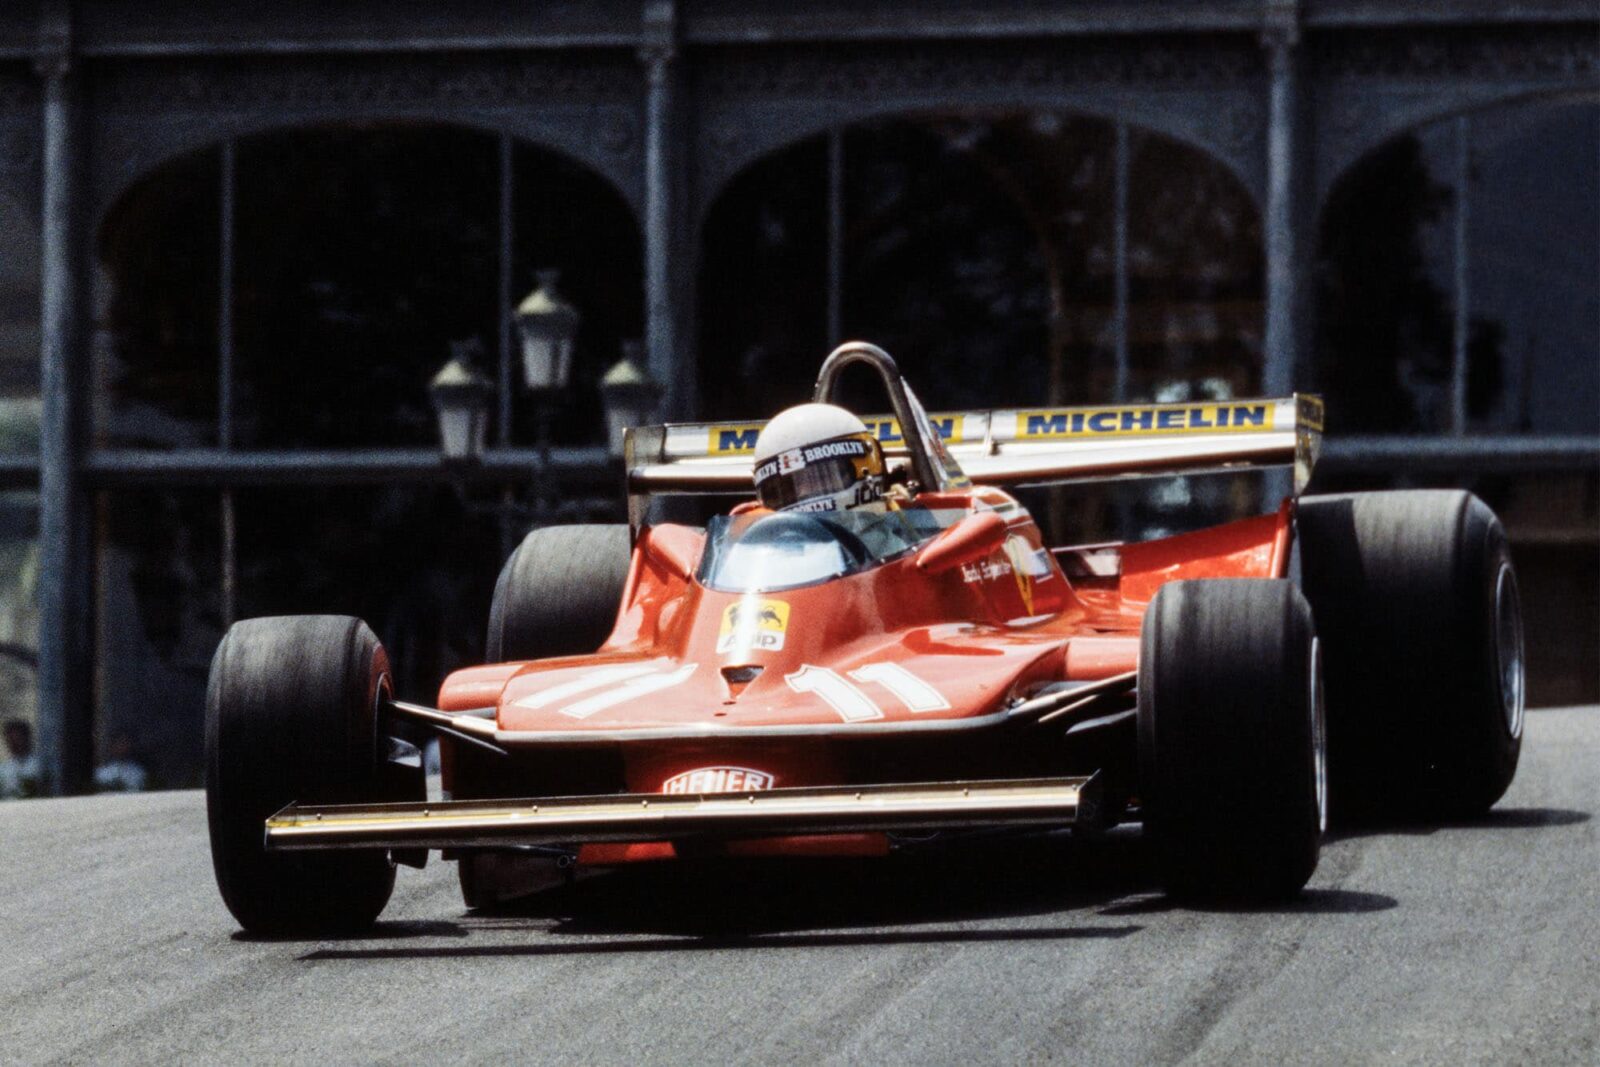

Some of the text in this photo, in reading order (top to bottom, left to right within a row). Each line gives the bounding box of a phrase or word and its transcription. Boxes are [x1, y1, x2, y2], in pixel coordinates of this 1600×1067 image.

[1027, 406, 1266, 435] MICHELIN
[804, 441, 865, 462] BROOKLYN
[785, 664, 950, 722] 11
